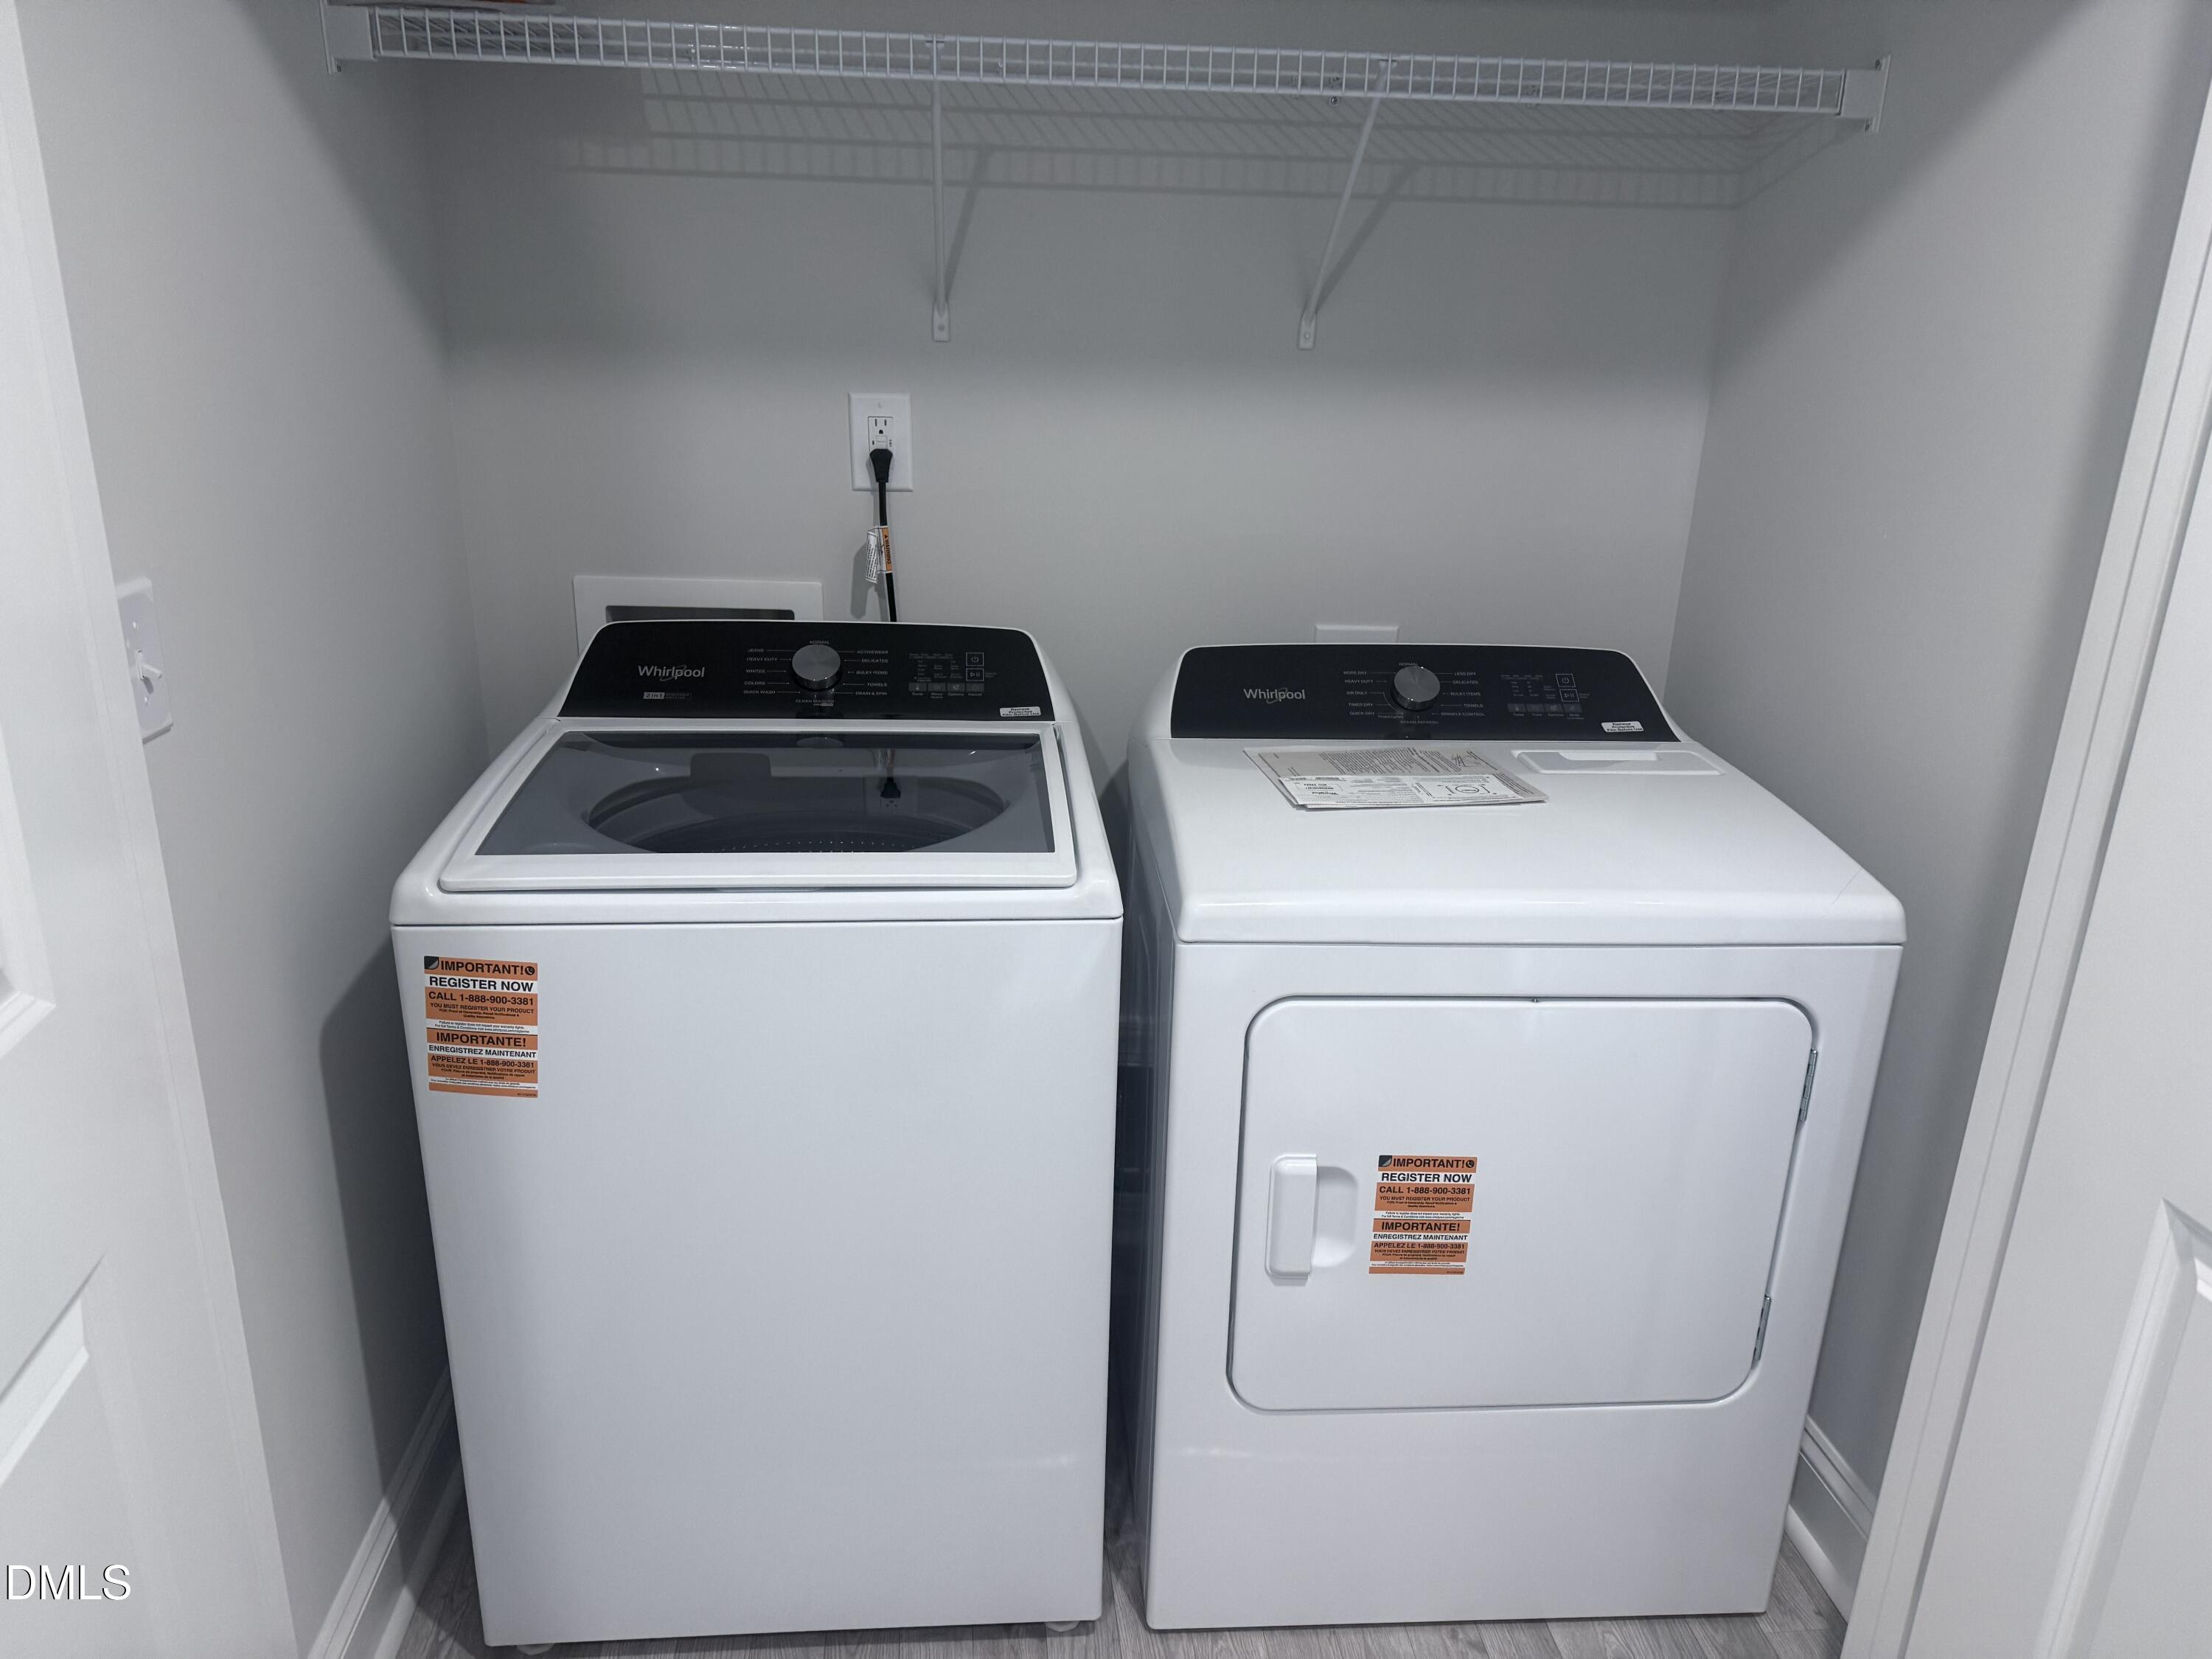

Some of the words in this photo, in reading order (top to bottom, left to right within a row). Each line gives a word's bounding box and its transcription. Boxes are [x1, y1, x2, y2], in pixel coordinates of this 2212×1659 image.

[638, 665, 706, 681] Whirlpool
[1243, 688, 1306, 703] Whirlpool
[441, 960, 524, 975] IMPORTANT!
[429, 975, 497, 990] REGISTER
[501, 981, 534, 992] NOW
[428, 991, 457, 1001] CALL
[459, 993, 534, 1006] 1-888-900-3381
[437, 1032, 526, 1047] IMPORTANTE!
[428, 1045, 484, 1055] ENREGISTREZ
[485, 1049, 537, 1058] MAINTENANT
[431, 1055, 466, 1065] APPELEZ
[467, 1057, 478, 1065] LE
[479, 1057, 535, 1068] 1-888-900-3381
[1393, 1158, 1465, 1169] IMPORTANT!
[1381, 1172, 1440, 1182] REGISTER
[1443, 1174, 1472, 1183] NOW
[1406, 1186, 1470, 1194] 1-888-900-3381
[1381, 1222, 1460, 1231] IMPORTANTE!
